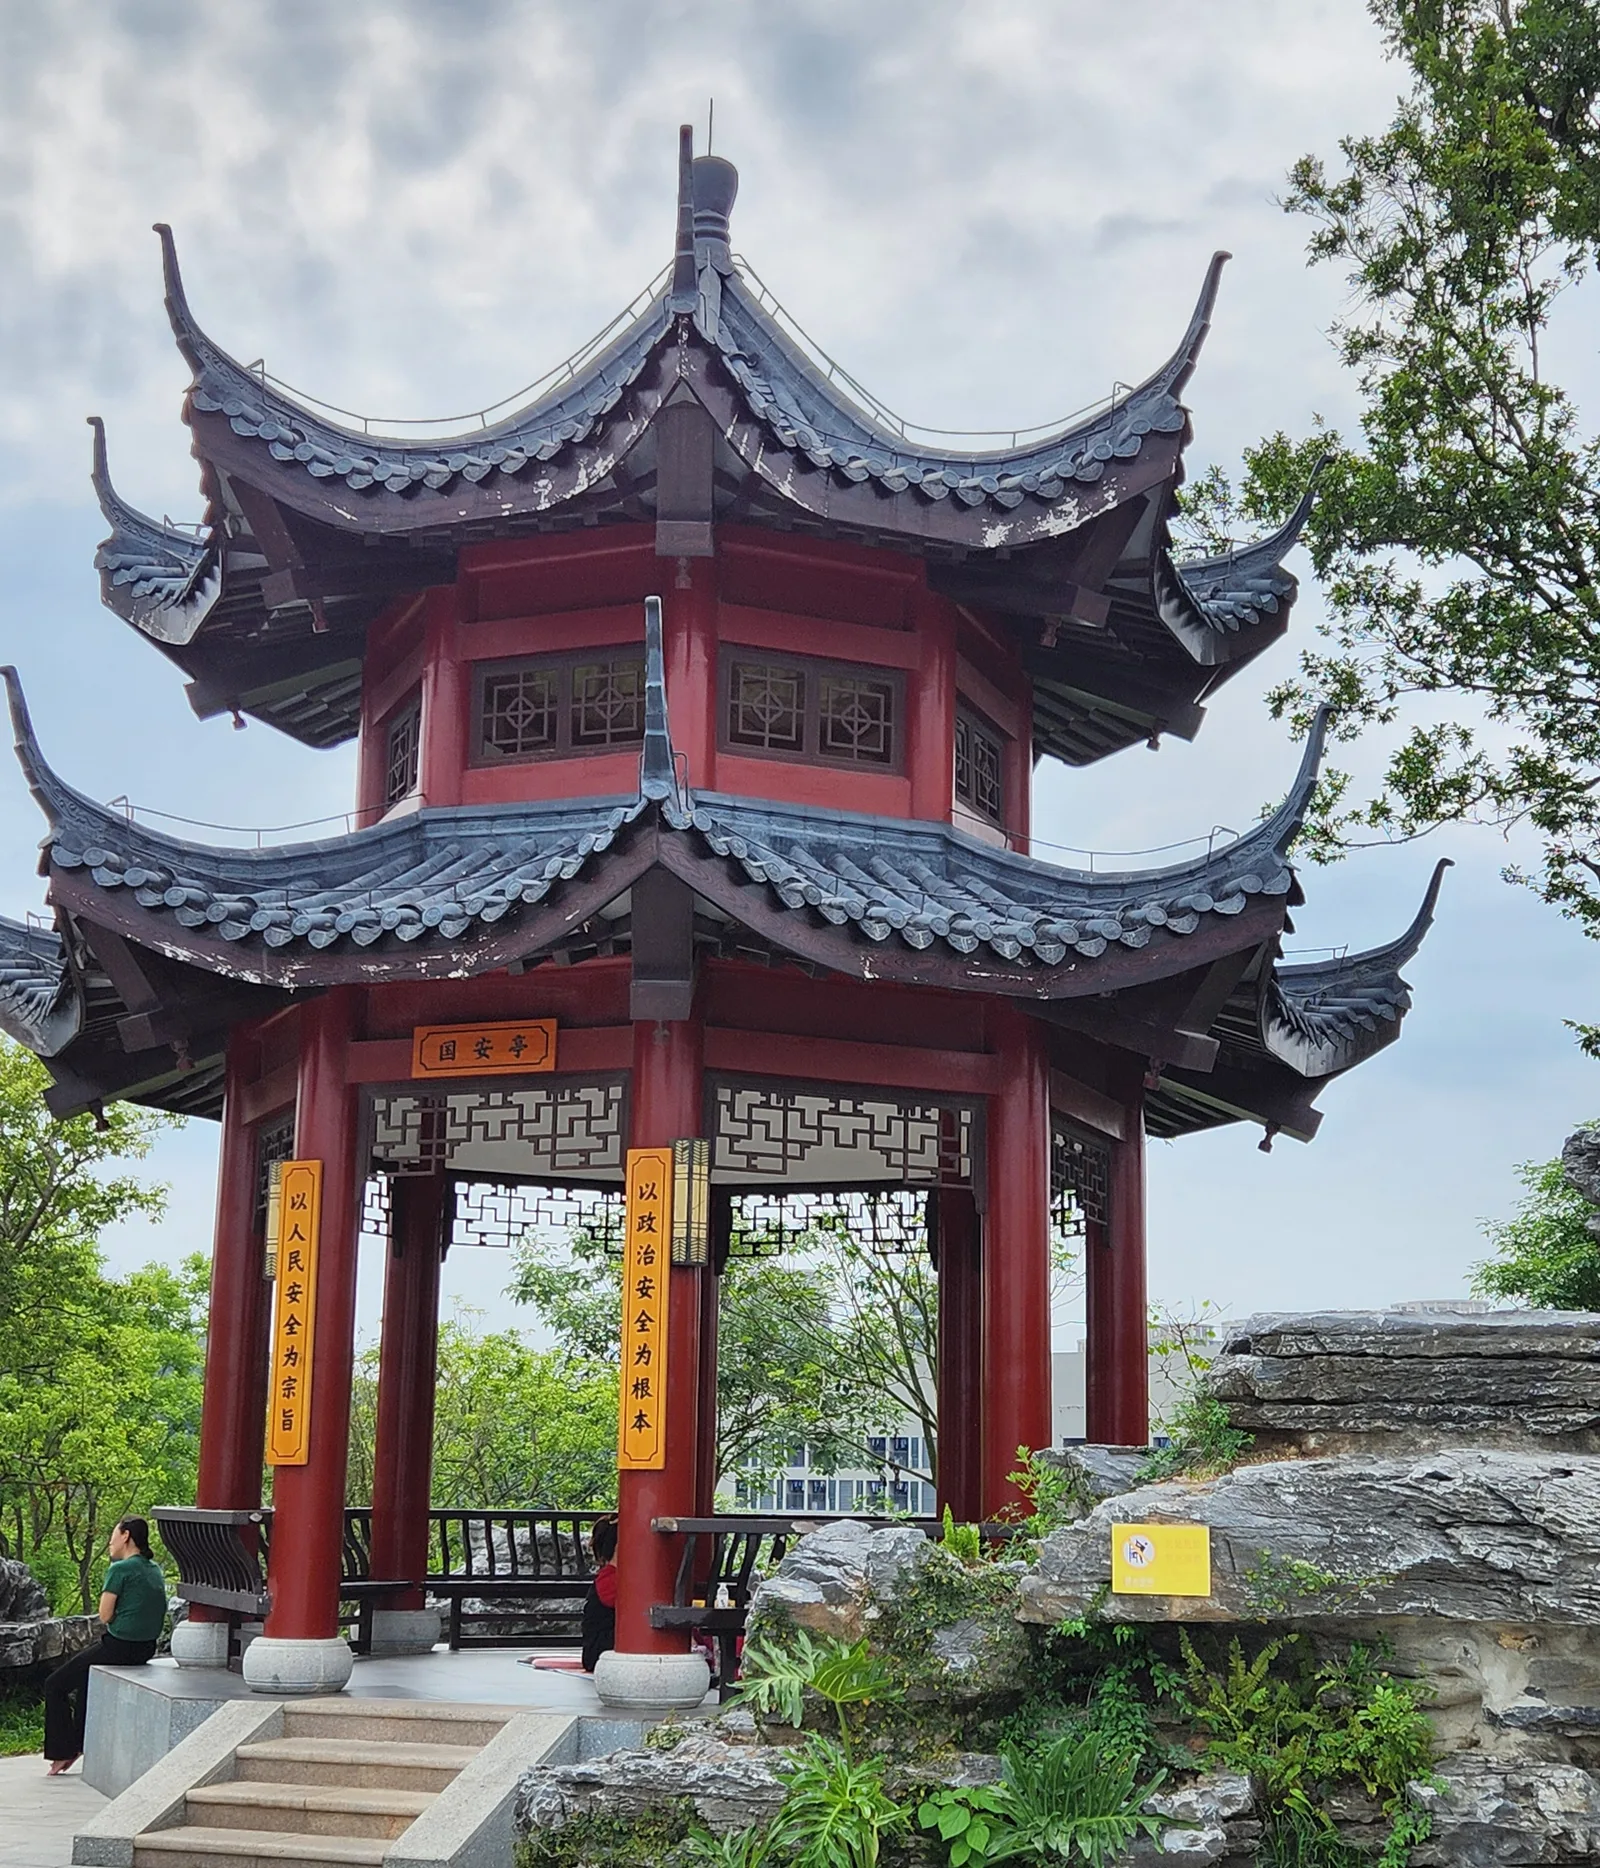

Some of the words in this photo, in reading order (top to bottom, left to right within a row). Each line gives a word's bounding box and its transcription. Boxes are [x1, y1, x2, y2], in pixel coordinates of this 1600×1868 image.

[439, 1034, 528, 1061] 国安亭
[281, 1192, 308, 1432] 以人民安全为宗旨
[630, 1182, 658, 1434] 以政治安全为根本
